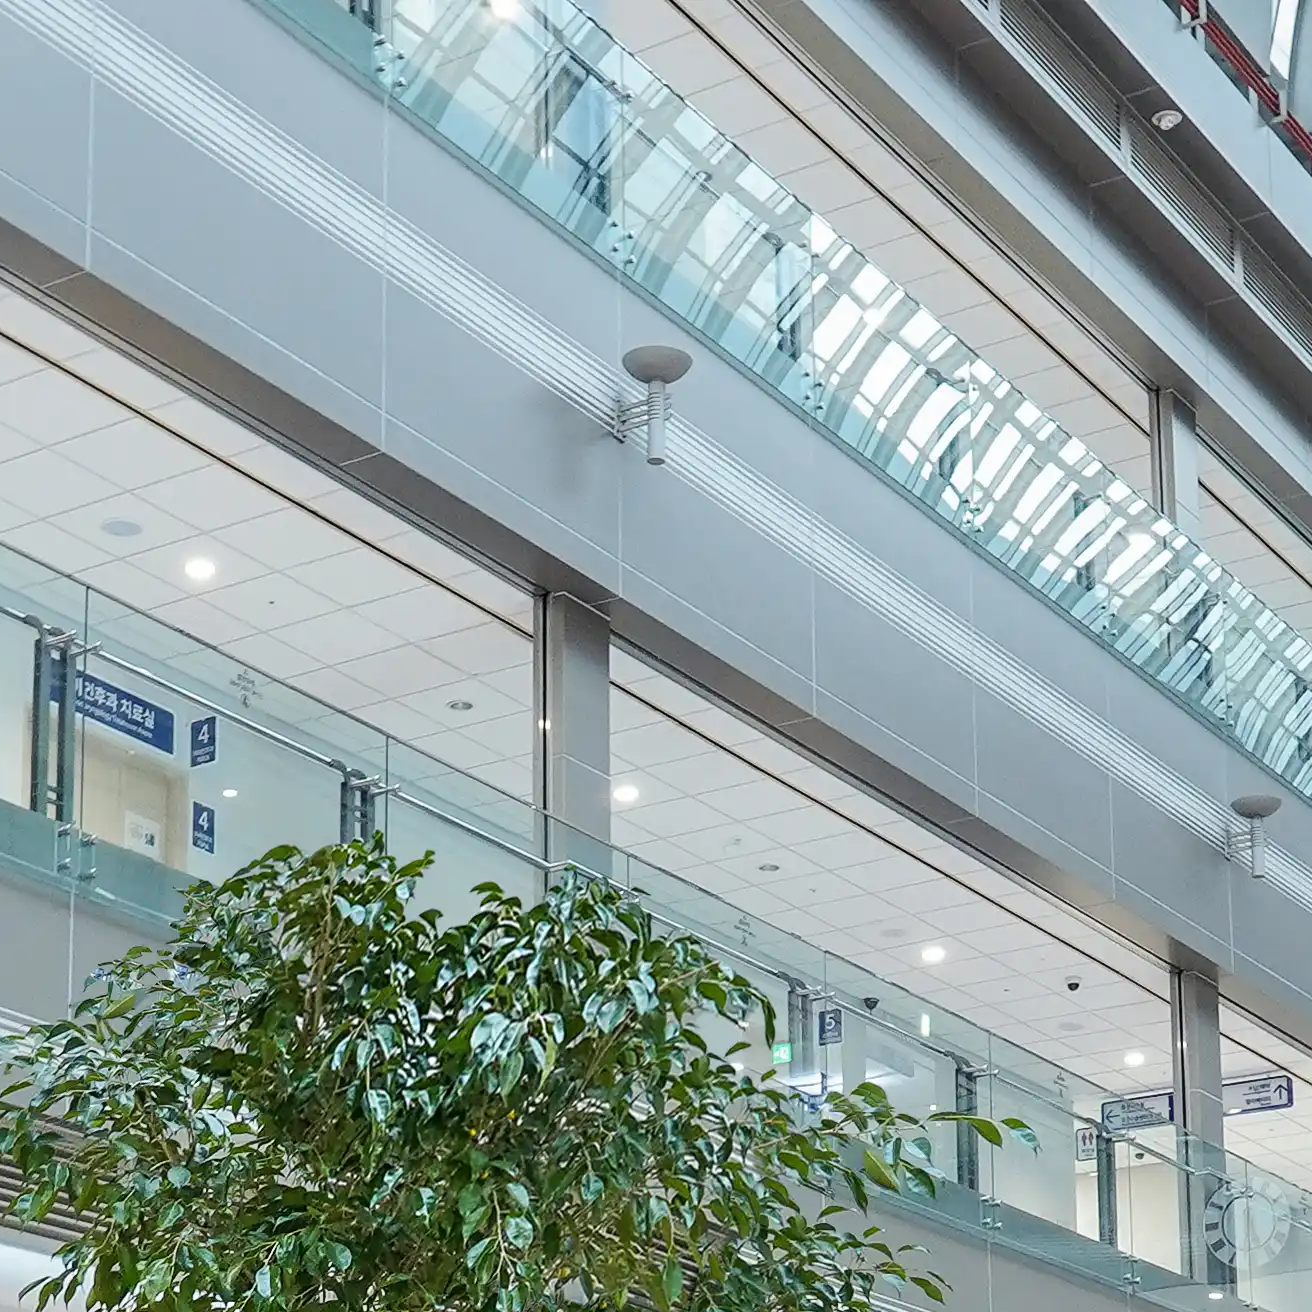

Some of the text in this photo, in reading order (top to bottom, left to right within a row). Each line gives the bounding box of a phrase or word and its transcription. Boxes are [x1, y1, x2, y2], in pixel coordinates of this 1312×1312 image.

[198, 724, 209, 743] 4
[199, 811, 209, 831] 4
[824, 1014, 836, 1030] 5
